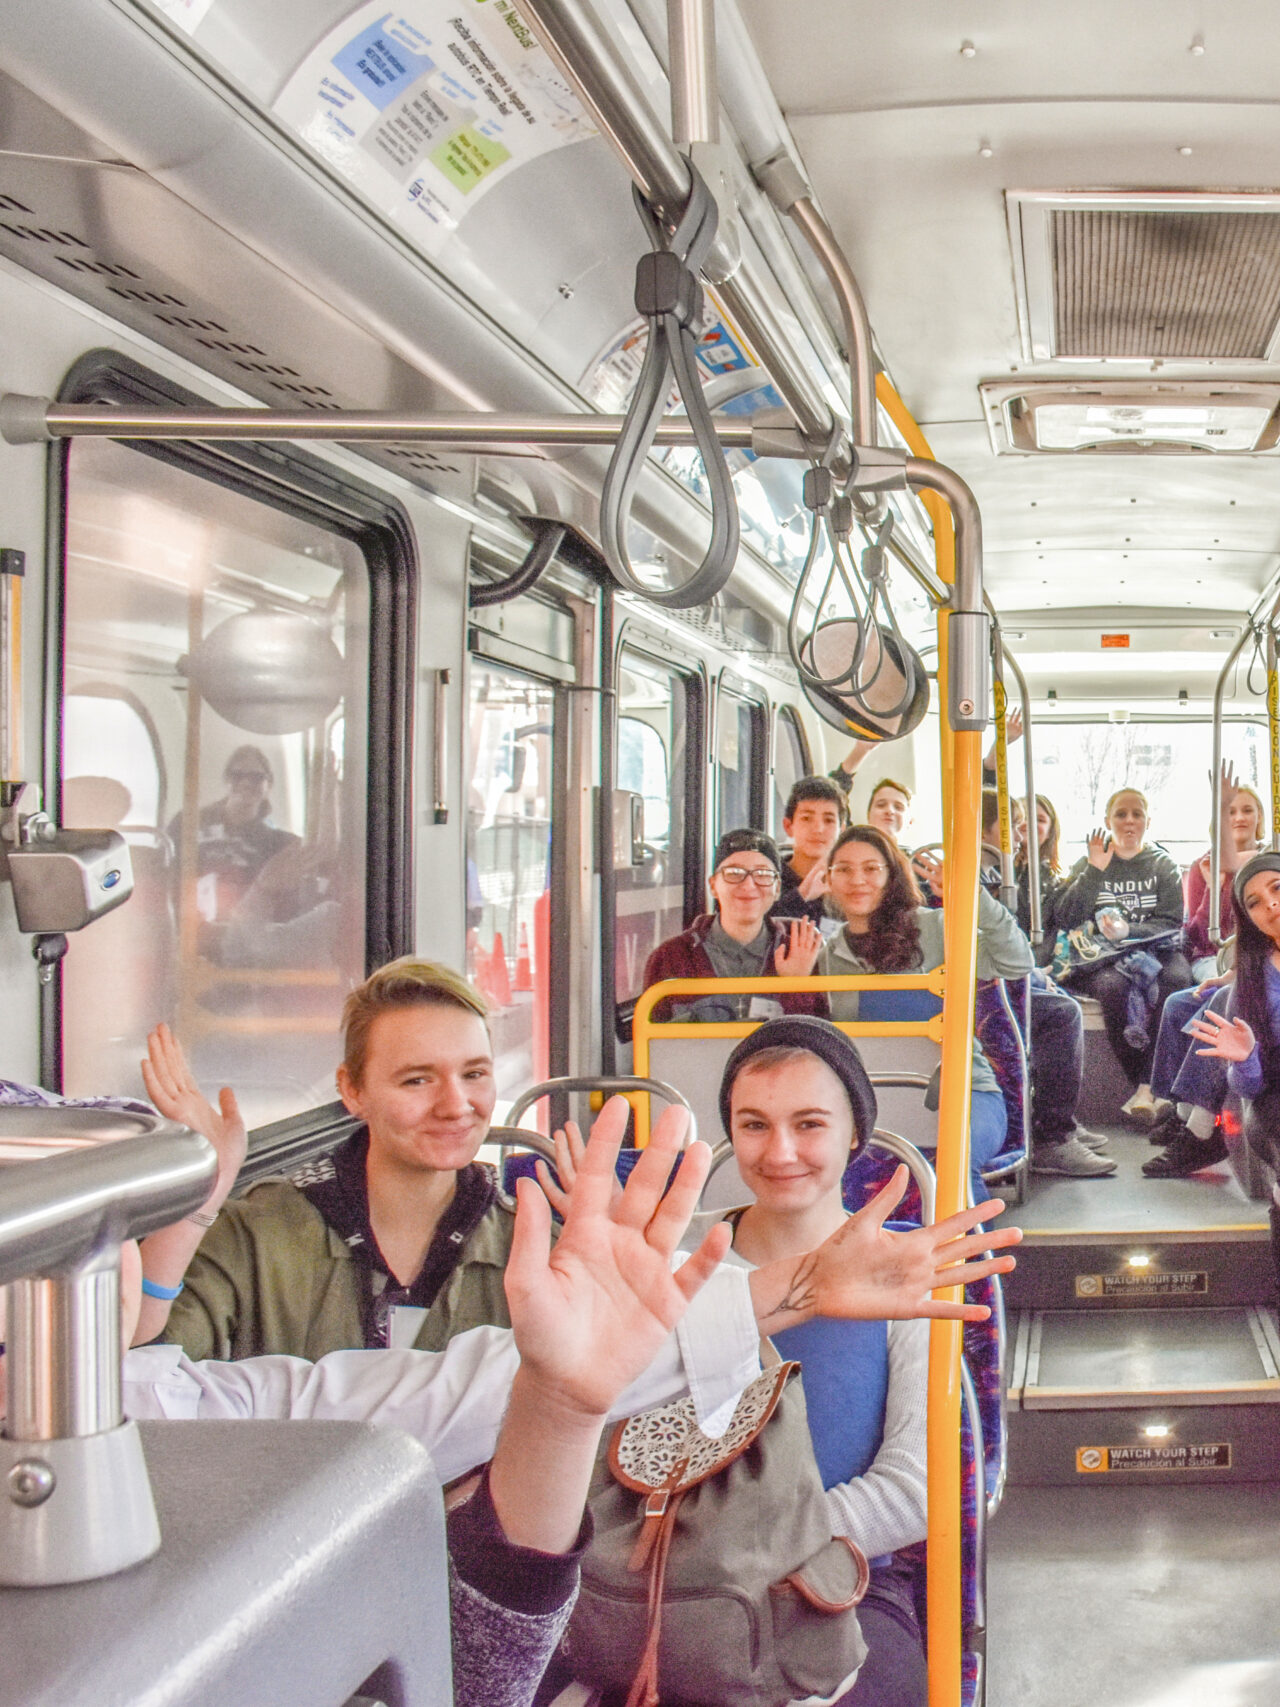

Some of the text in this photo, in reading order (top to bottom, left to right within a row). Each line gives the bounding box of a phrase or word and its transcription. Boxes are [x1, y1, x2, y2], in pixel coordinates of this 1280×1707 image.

[503, 10, 539, 51] NextBus!
[1272, 724, 1280, 758] CON
[1001, 806, 1009, 851] STEP
[1104, 1274, 1197, 1285] WATCH YOUR STEP
[1110, 1446, 1219, 1459] WATCH YOUR STEP
[1112, 1457, 1217, 1468] Precaución al Subir
